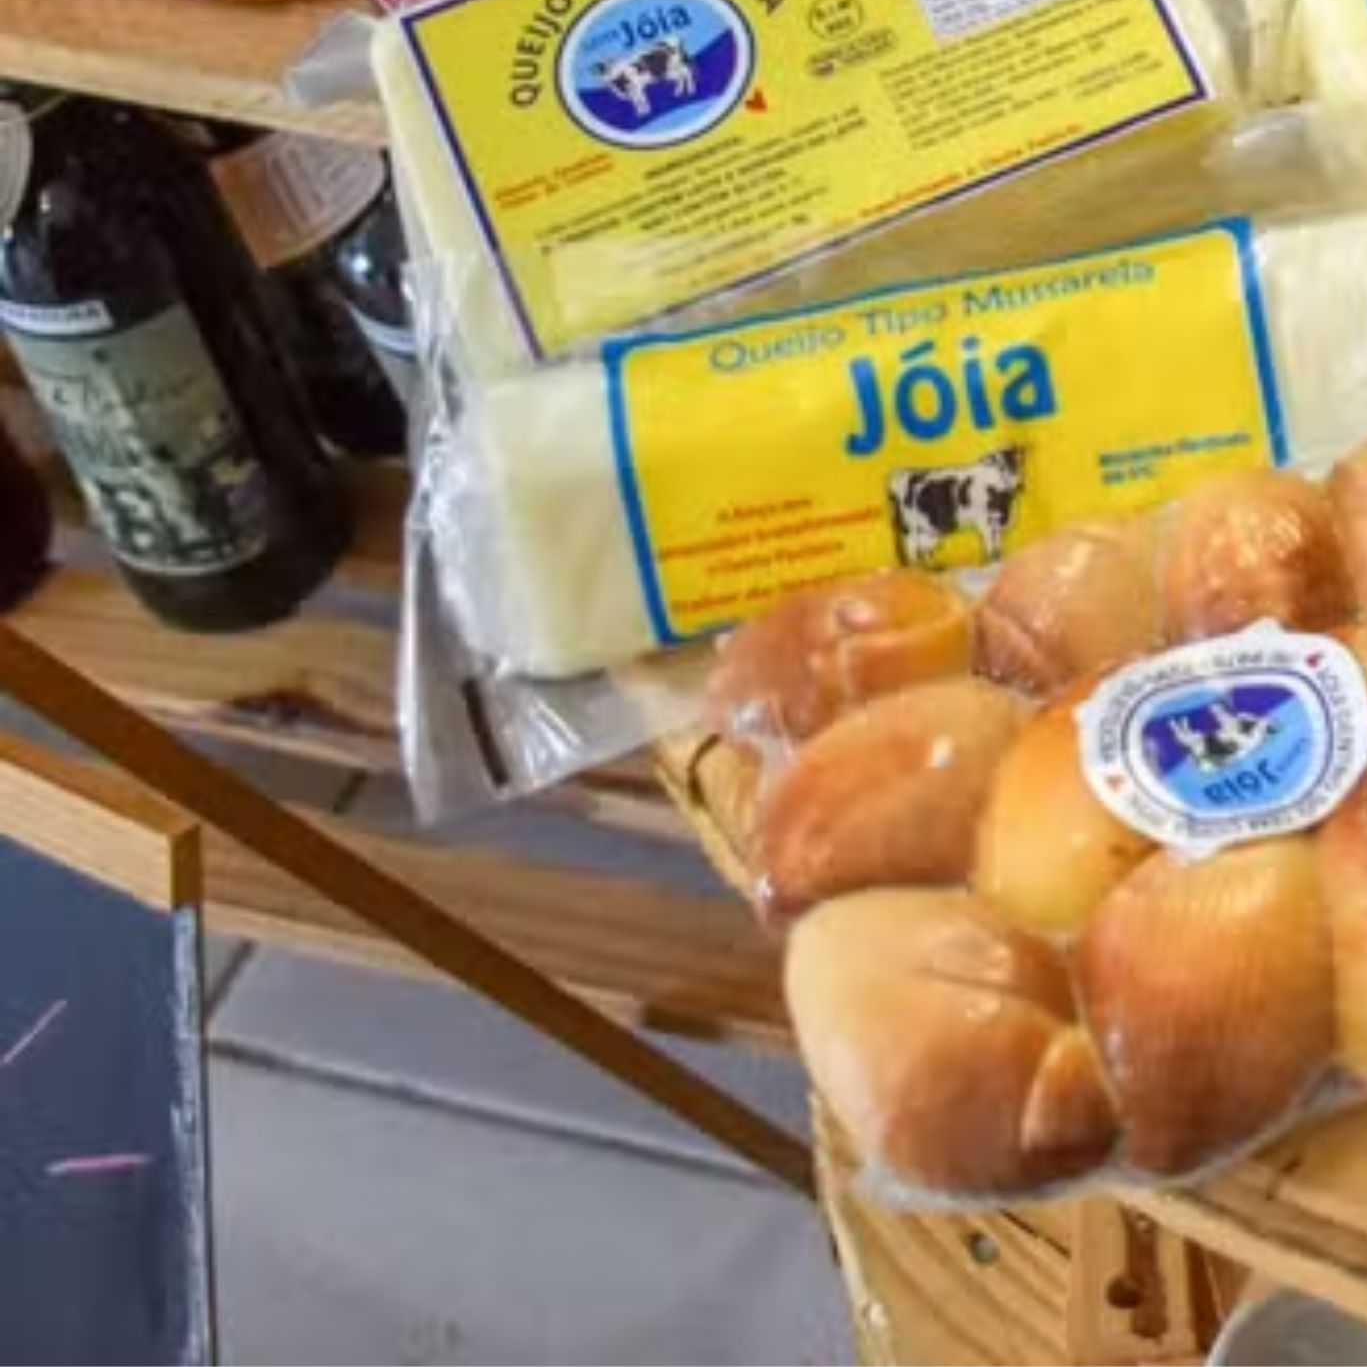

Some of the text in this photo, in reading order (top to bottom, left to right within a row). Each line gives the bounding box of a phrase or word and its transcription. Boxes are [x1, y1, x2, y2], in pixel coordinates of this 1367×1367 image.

[619, 3, 693, 50] Jóia
[707, 259, 1157, 376] Queijo Tipo Mussarela
[844, 336, 1058, 458] Jóia
[1201, 758, 1282, 806] Jóia
